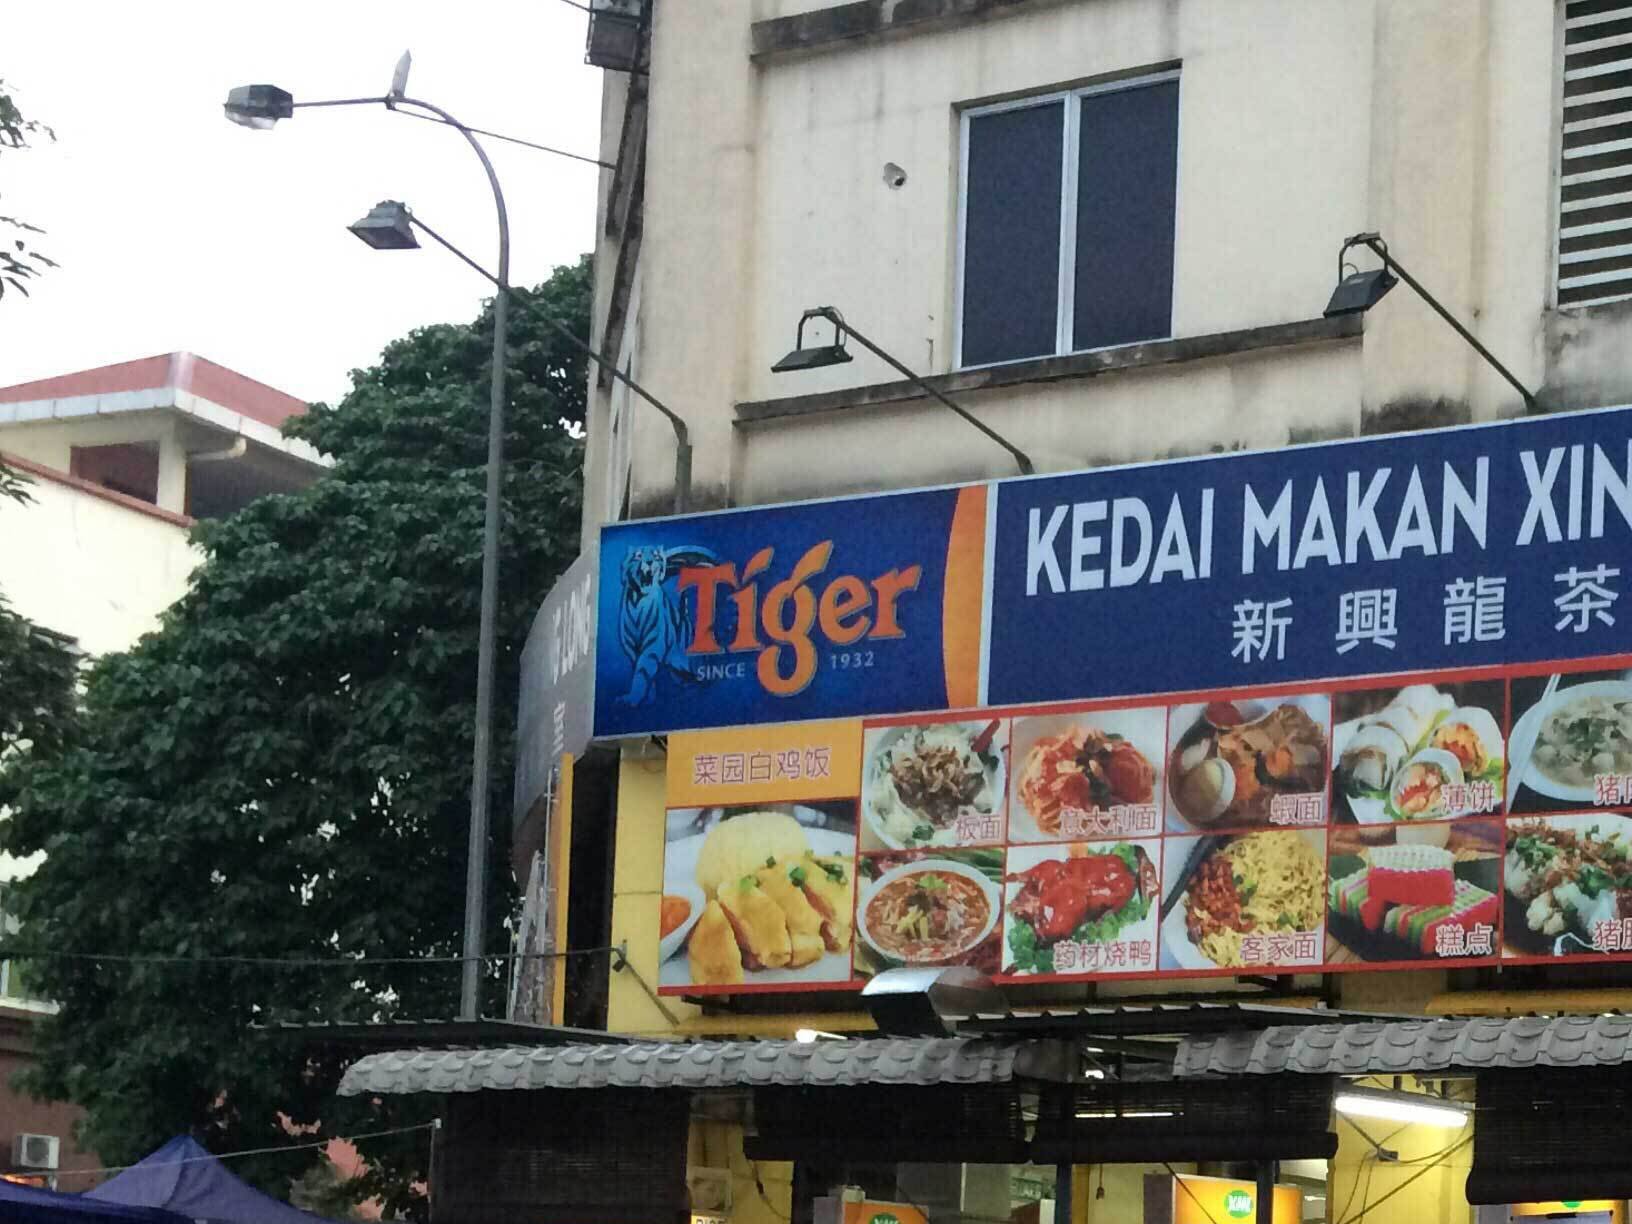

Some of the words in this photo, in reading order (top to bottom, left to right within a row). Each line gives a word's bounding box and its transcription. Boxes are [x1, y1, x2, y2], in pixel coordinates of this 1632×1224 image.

[1025, 487, 1214, 596] KEDAI
[1241, 455, 1490, 575] MAKAN
[677, 539, 923, 697] Tiger
[696, 660, 747, 682] SINCE
[830, 650, 875, 670] 1932
[693, 747, 832, 785] 菜园白鸡饭
[1441, 782, 1496, 813] 薄饼
[955, 814, 1001, 841] 板面
[1053, 938, 1152, 971] 药材烧鸭
[1241, 931, 1318, 962] 客家面
[1436, 923, 1493, 956] 糕点
